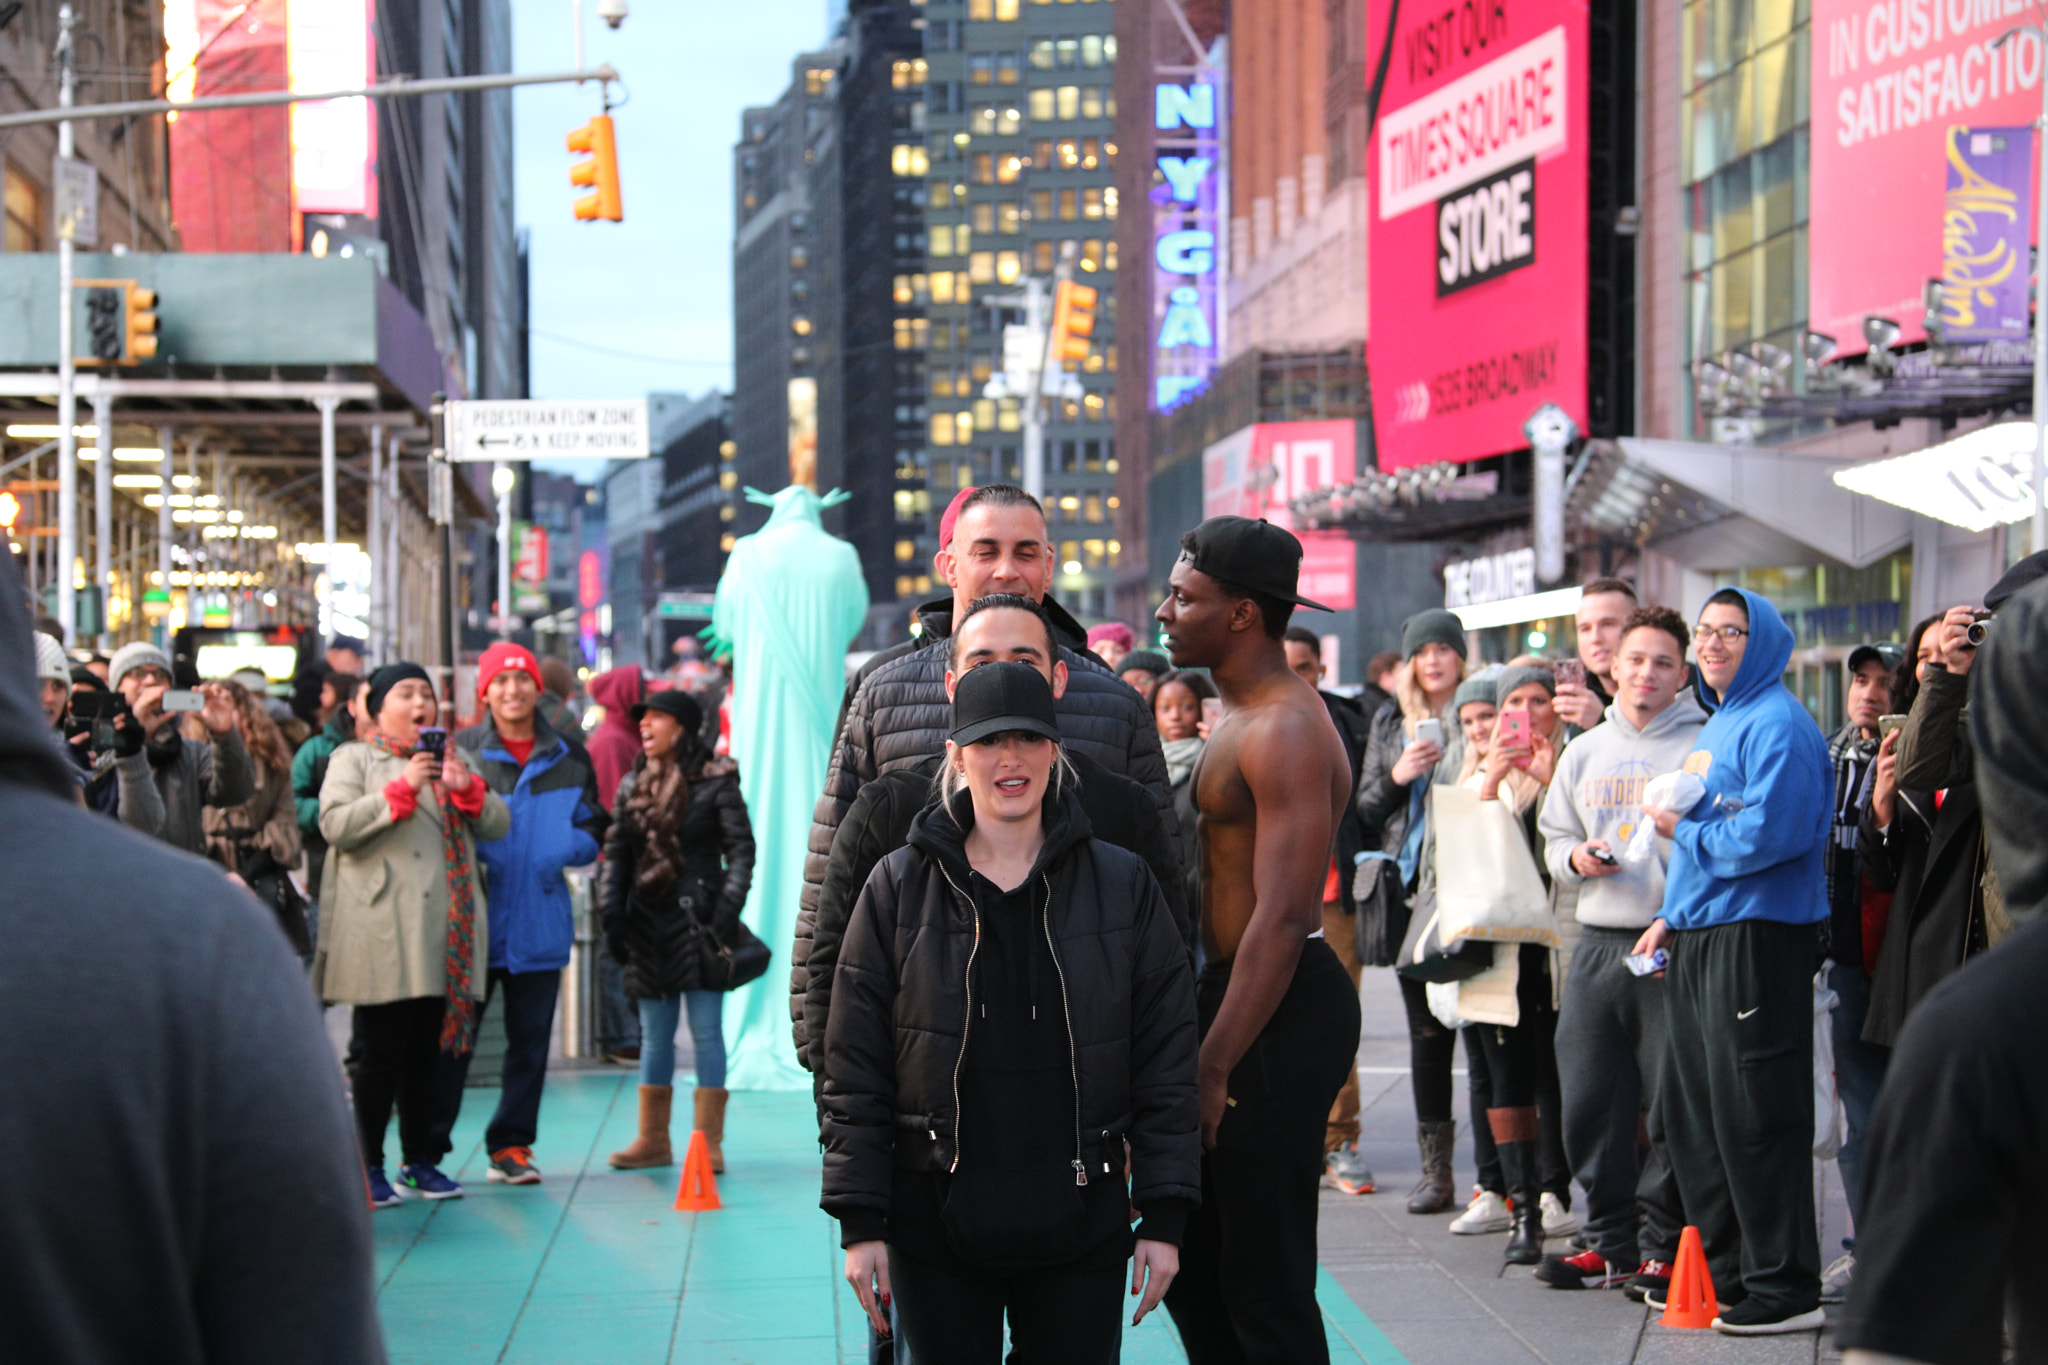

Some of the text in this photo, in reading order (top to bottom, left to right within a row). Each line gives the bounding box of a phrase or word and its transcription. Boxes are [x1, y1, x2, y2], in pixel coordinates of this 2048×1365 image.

[1406, 0, 1508, 85] VISIT OUR
[1829, 0, 2048, 79] IN CUSTO
[1389, 57, 1553, 195] TIMES SQUARE
[1837, 28, 2044, 147] SATISFACTIO
[1439, 170, 1532, 285] STORE
[1944, 124, 2018, 327] Aladdin
[1465, 340, 1559, 408] BROADWAY
[473, 408, 636, 427] PEDESTRIAN FLOW ZONE
[548, 431, 637, 449] KEEP MOVING
[1584, 776, 1656, 809] LYNDHU
